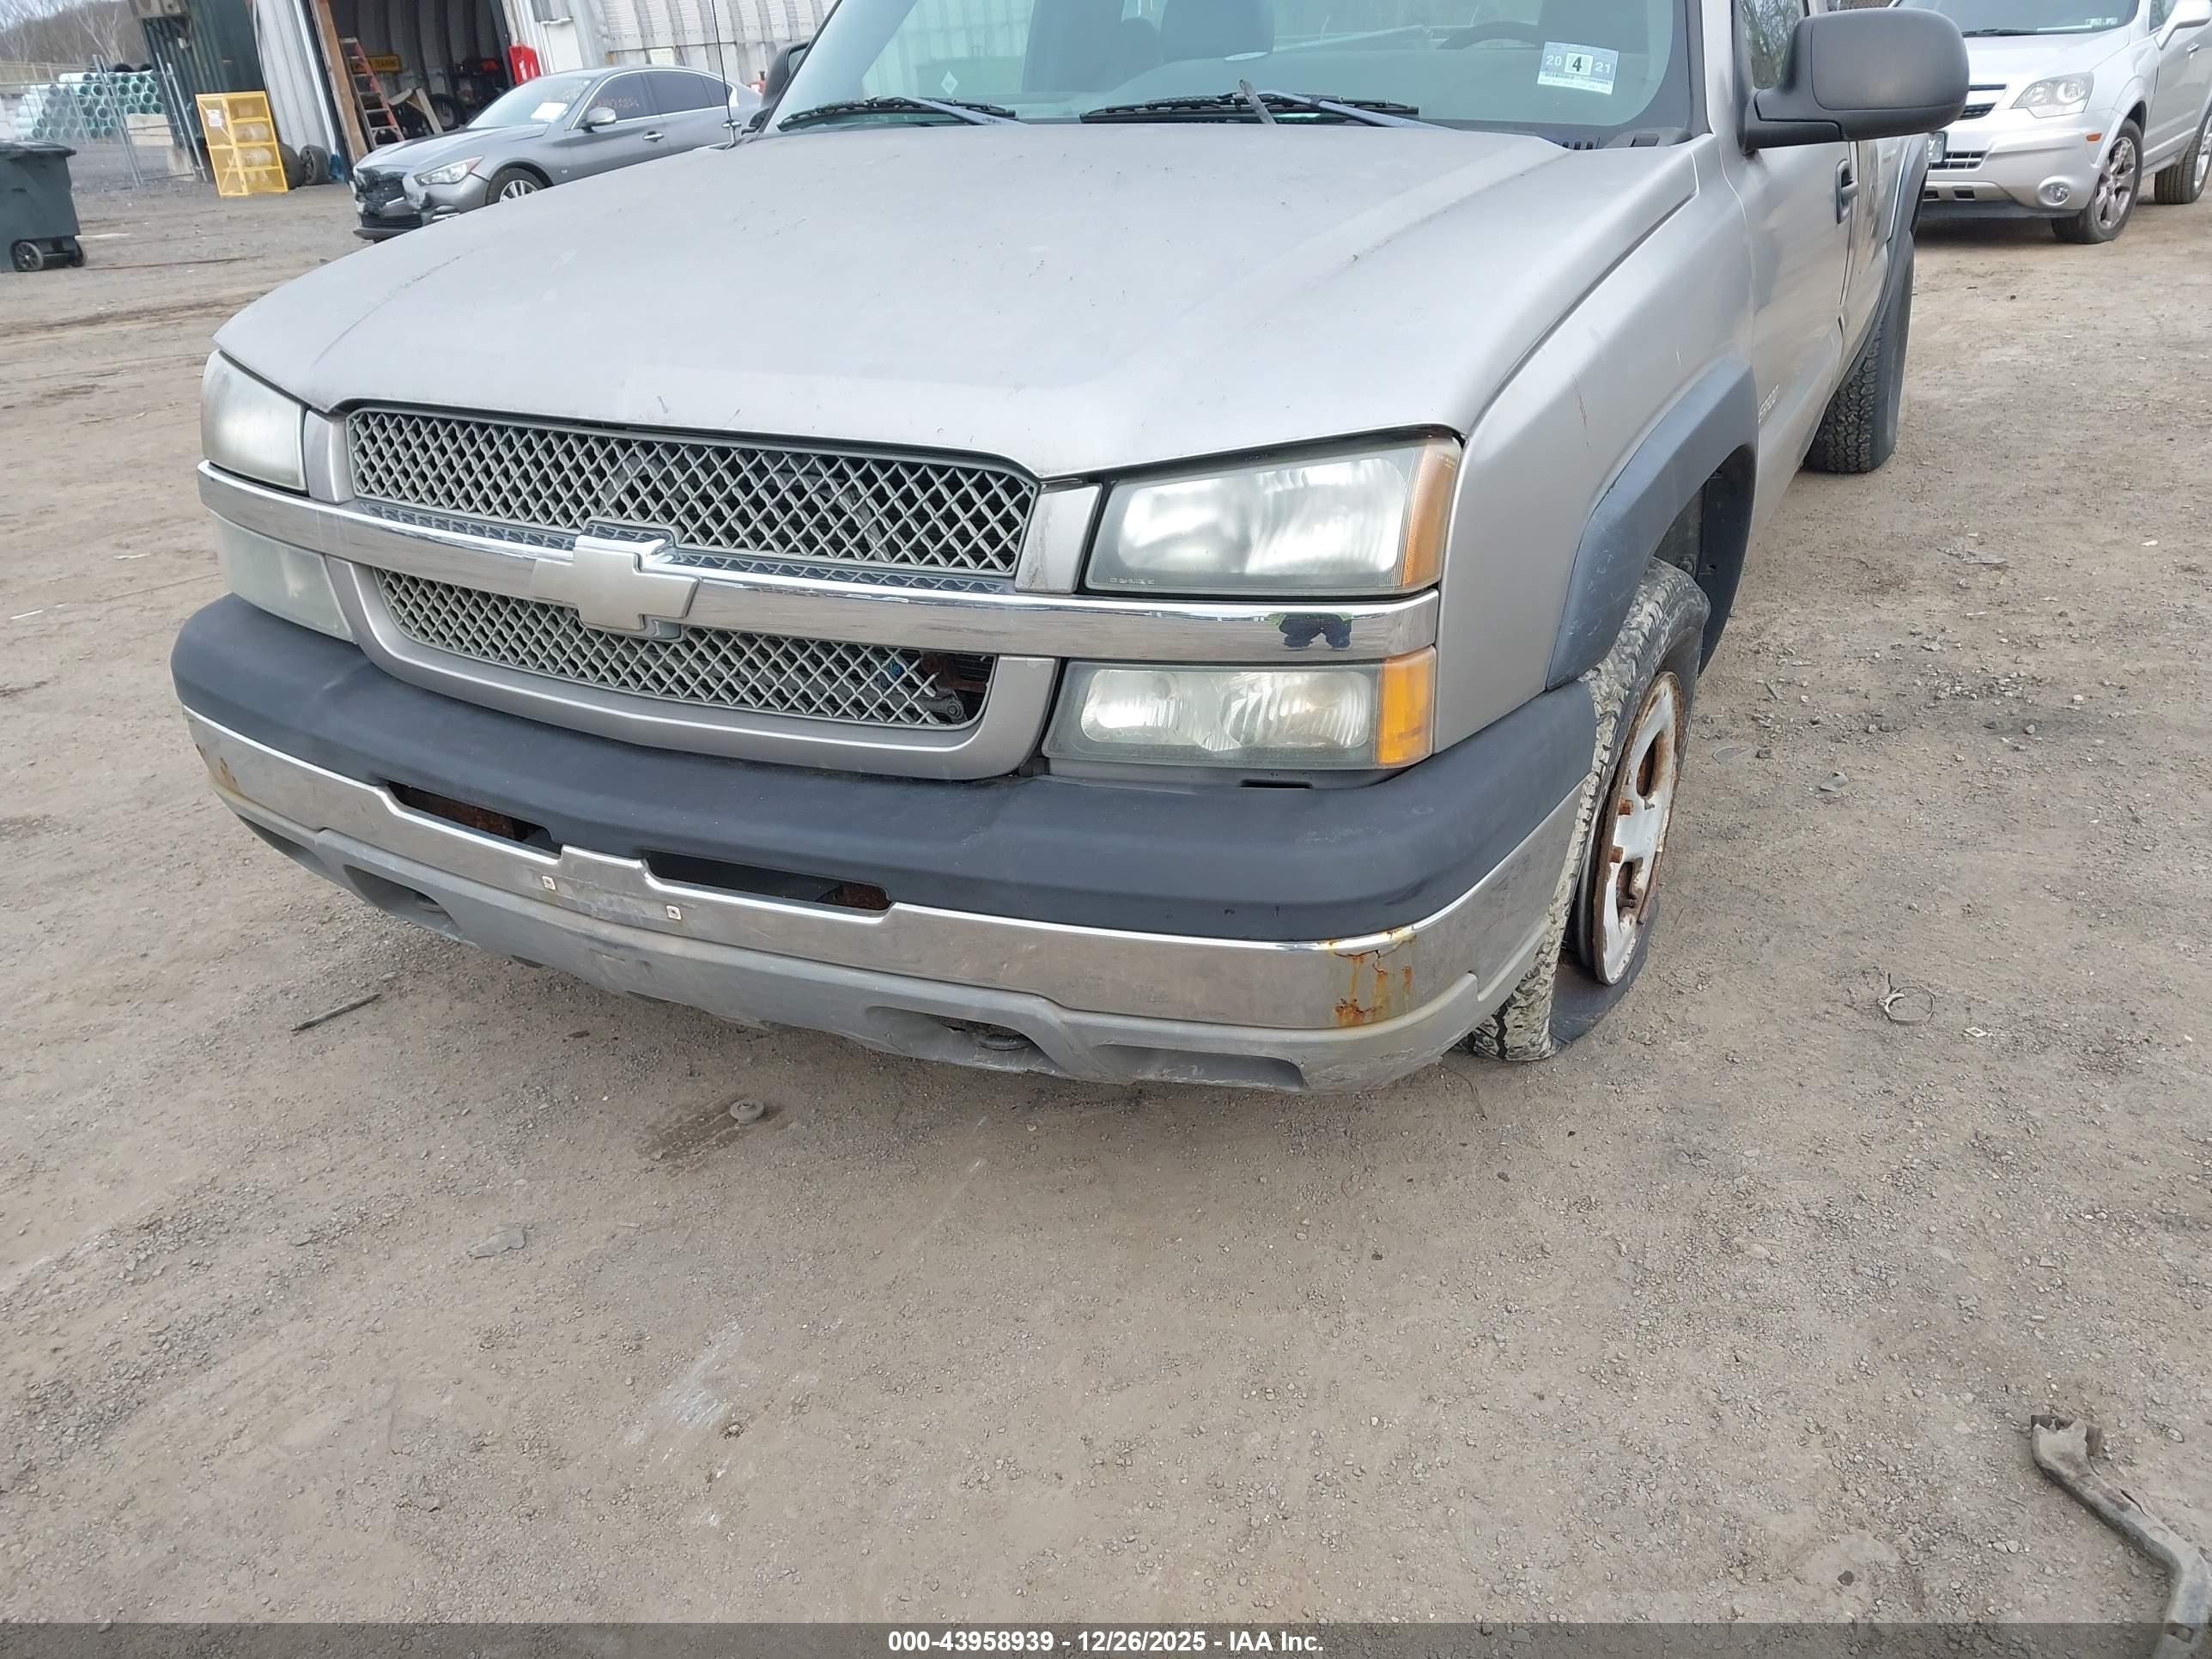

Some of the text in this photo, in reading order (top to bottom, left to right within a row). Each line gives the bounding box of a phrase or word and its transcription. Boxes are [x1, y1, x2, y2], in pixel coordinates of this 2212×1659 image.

[1546, 54, 1611, 74] 20 4 21
